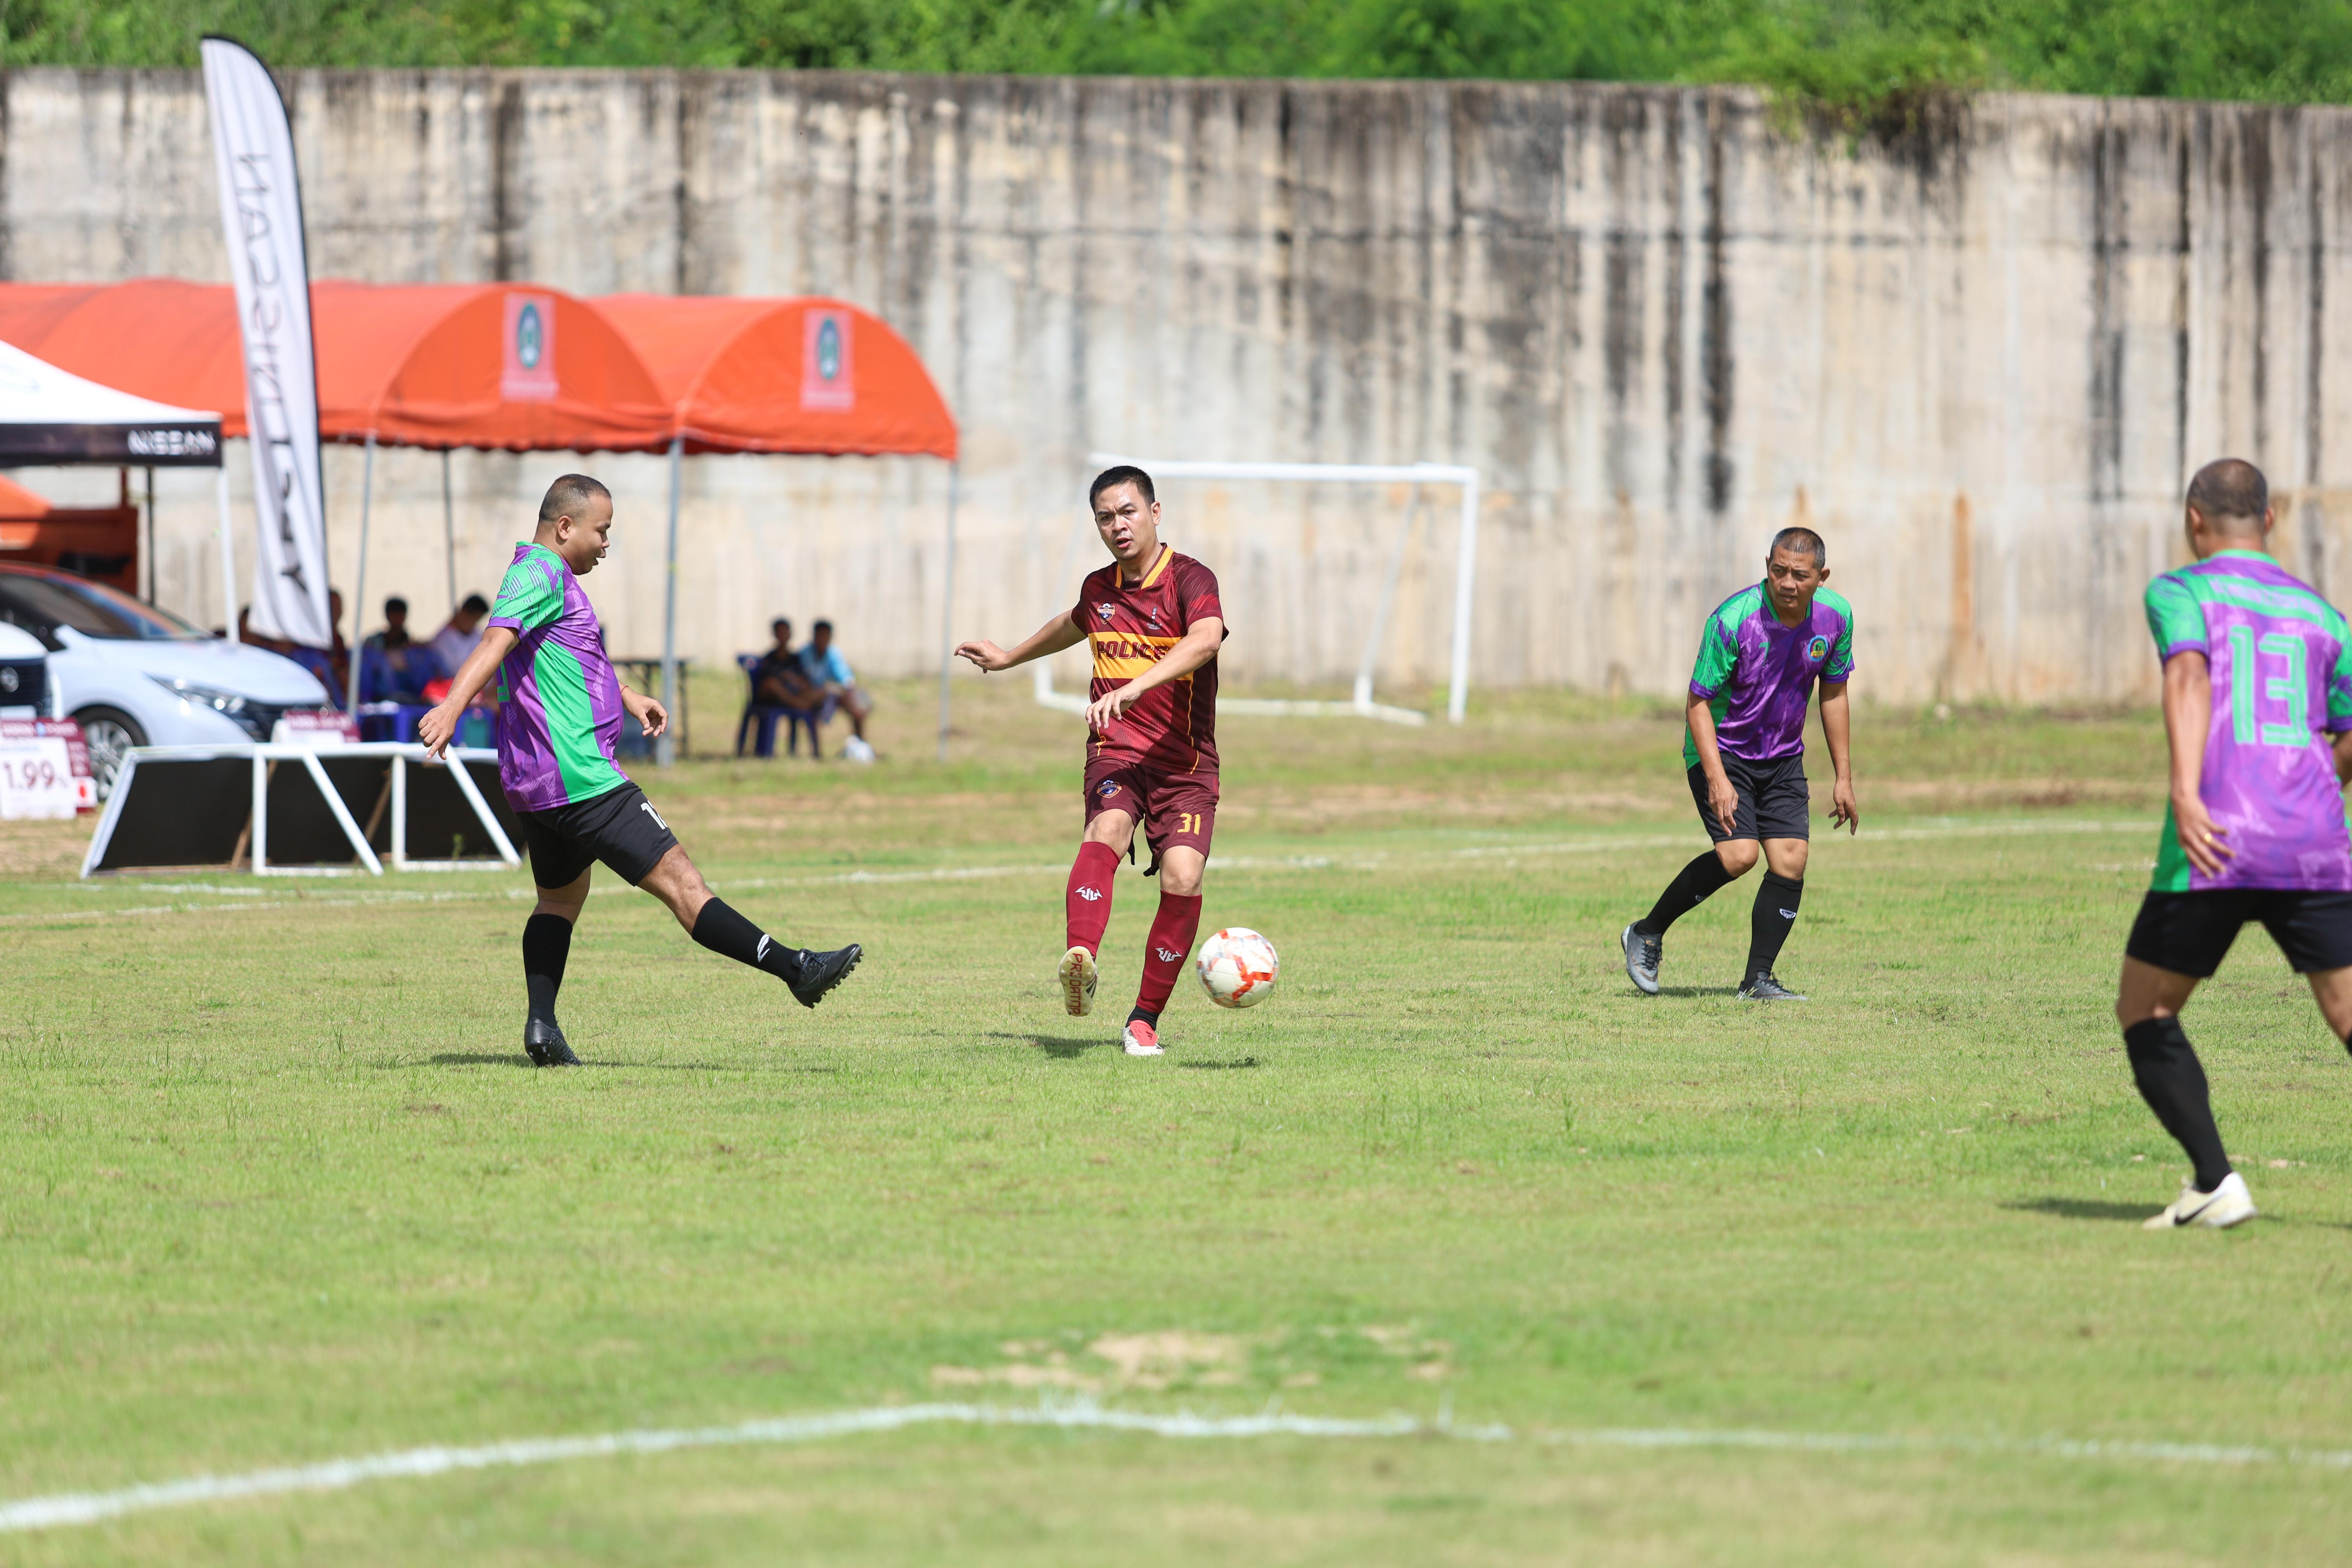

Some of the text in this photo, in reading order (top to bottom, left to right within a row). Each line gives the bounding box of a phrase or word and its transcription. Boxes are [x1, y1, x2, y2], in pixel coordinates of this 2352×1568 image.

[1096, 641, 1170, 660] POLICE
[2229, 625, 2311, 747] 13
[640, 800, 668, 830] 1
[1177, 813, 1201, 836] 31
[1069, 953, 1083, 1015] PREDATOR
